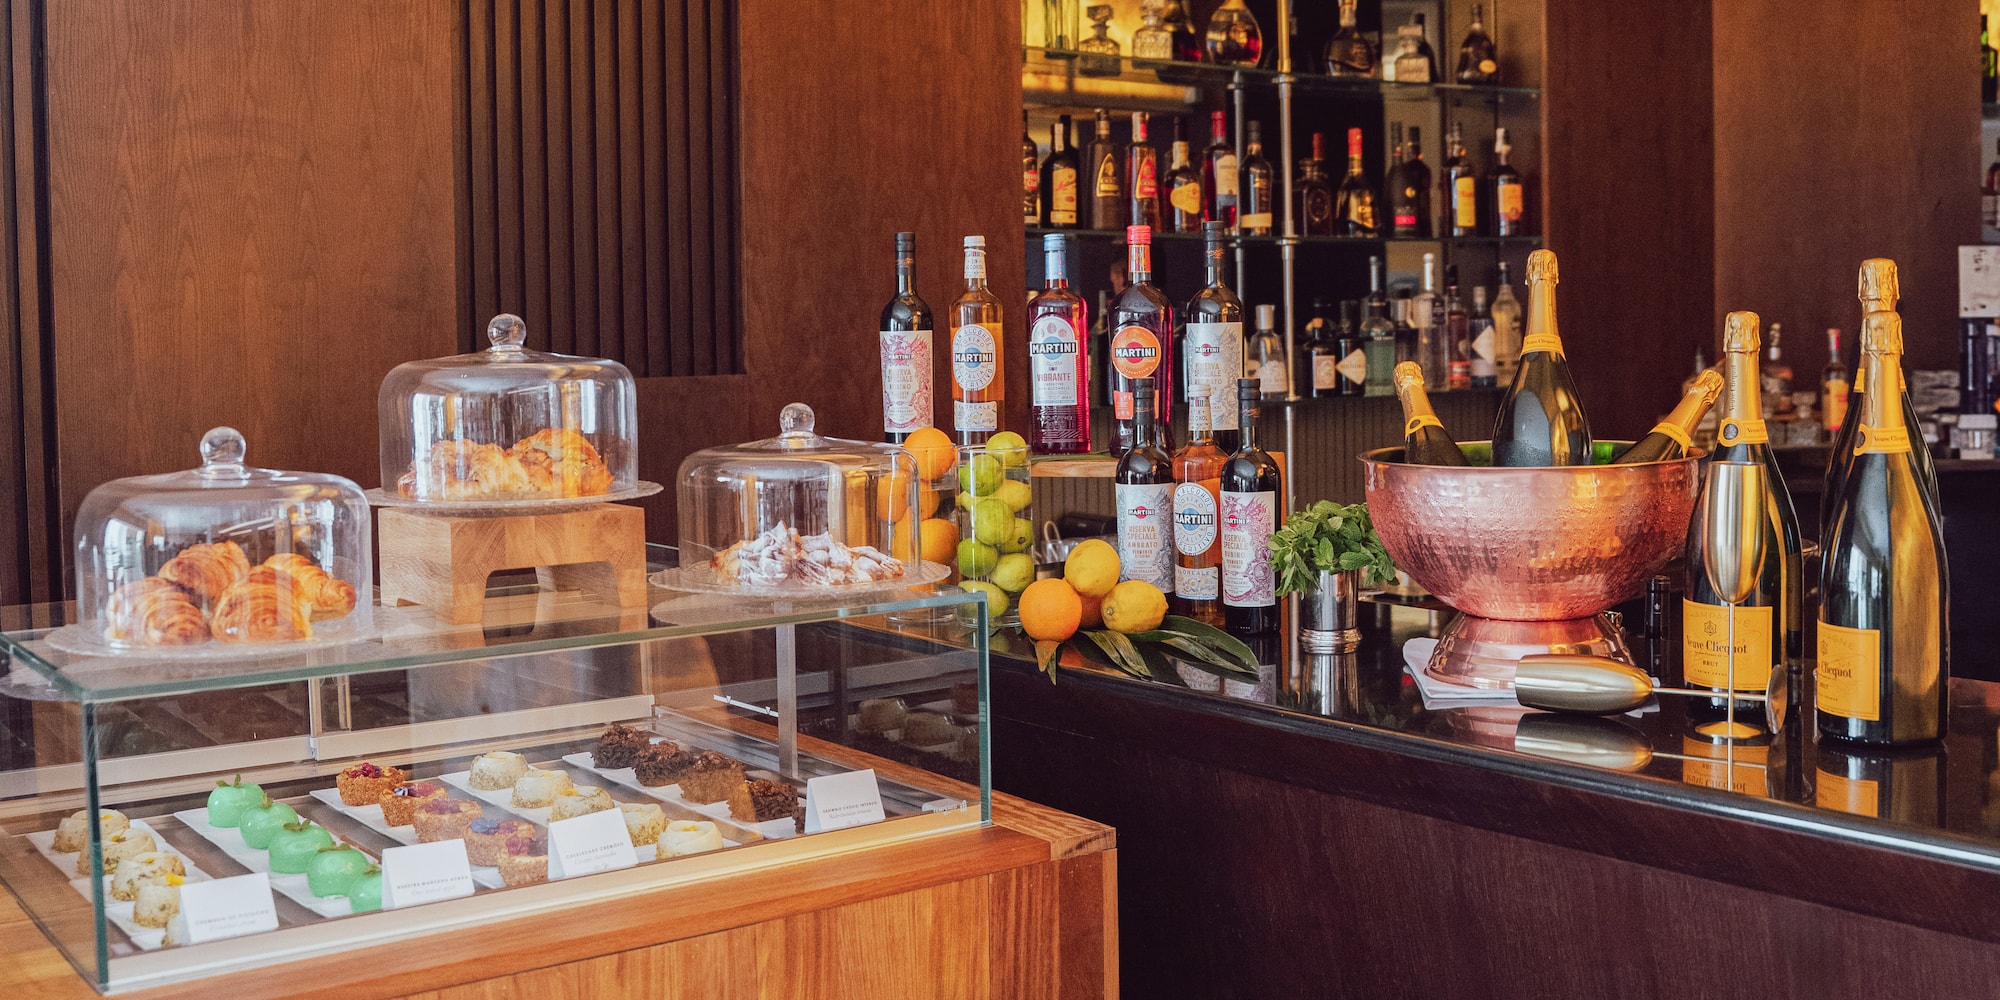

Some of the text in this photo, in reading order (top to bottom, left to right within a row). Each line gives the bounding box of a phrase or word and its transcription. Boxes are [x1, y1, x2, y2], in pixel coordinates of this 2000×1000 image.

[1032, 342, 1076, 354] MARTINI
[1115, 348, 1156, 358] MARTINI
[954, 353, 993, 362] MARTINI
[1037, 373, 1072, 381] VIBRANTE
[1182, 486, 1213, 507] ALCOHOL
[1176, 514, 1212, 524] MARTINI
[1224, 542, 1248, 550] SPECIALE
[1687, 636, 1704, 650] Veuve
[1821, 661, 1852, 678] Clicquot
